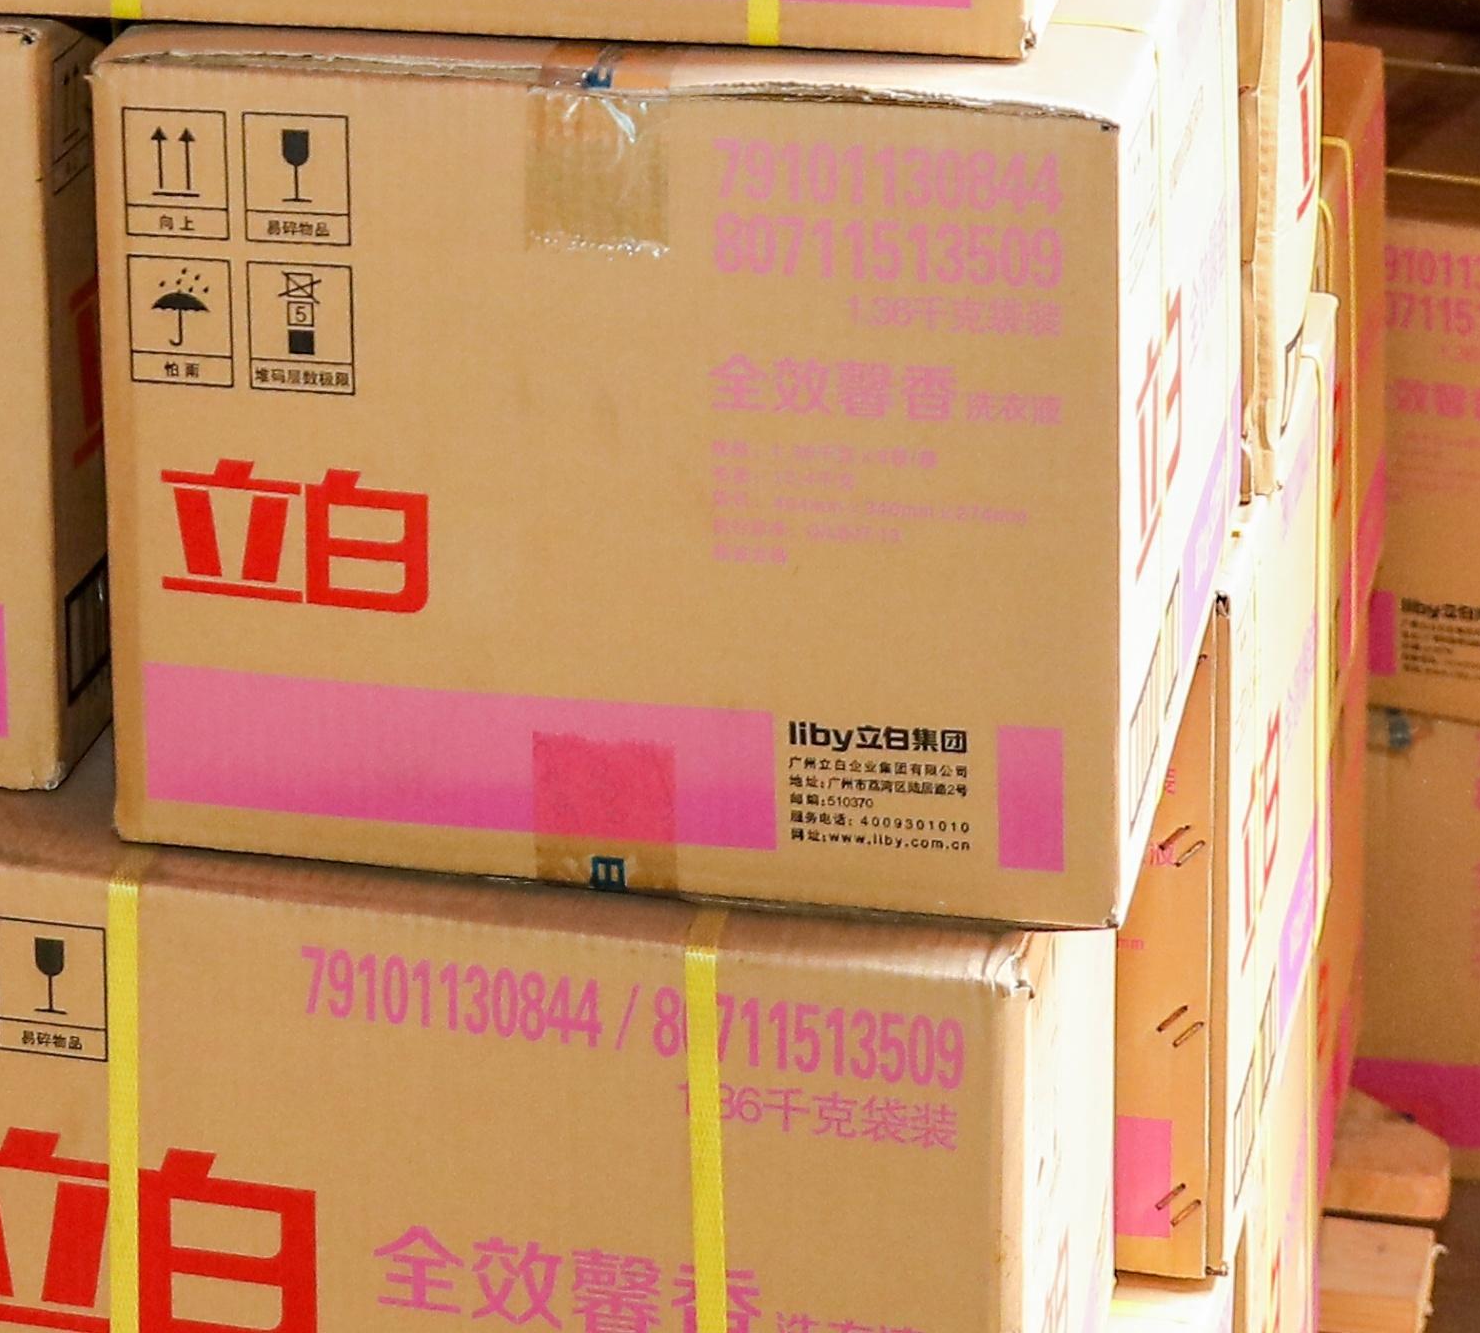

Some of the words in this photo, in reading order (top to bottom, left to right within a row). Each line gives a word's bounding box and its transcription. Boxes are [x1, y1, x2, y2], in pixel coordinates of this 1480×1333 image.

[714, 138, 1062, 219] 79101130844
[160, 215, 194, 231] 向上
[268, 221, 329, 237] 易碎物品
[714, 205, 1063, 289] 80711513509
[710, 355, 958, 421] 全效馨香
[162, 459, 428, 613] 立白
[790, 722, 967, 753] liby立白集团
[789, 756, 968, 779] 广州立白企业集团有限公司
[791, 810, 852, 827] 服务电话:
[860, 815, 970, 834] 4009301010
[791, 828, 970, 851] 网址:www.liby.com.cn
[301, 946, 603, 1048] 79101130844
[614, 983, 643, 1050] /
[652, 993, 966, 1088] 8711513509
[19, 1029, 85, 1053] 易碎物品
[679, 1078, 964, 1151] 136千克袋装
